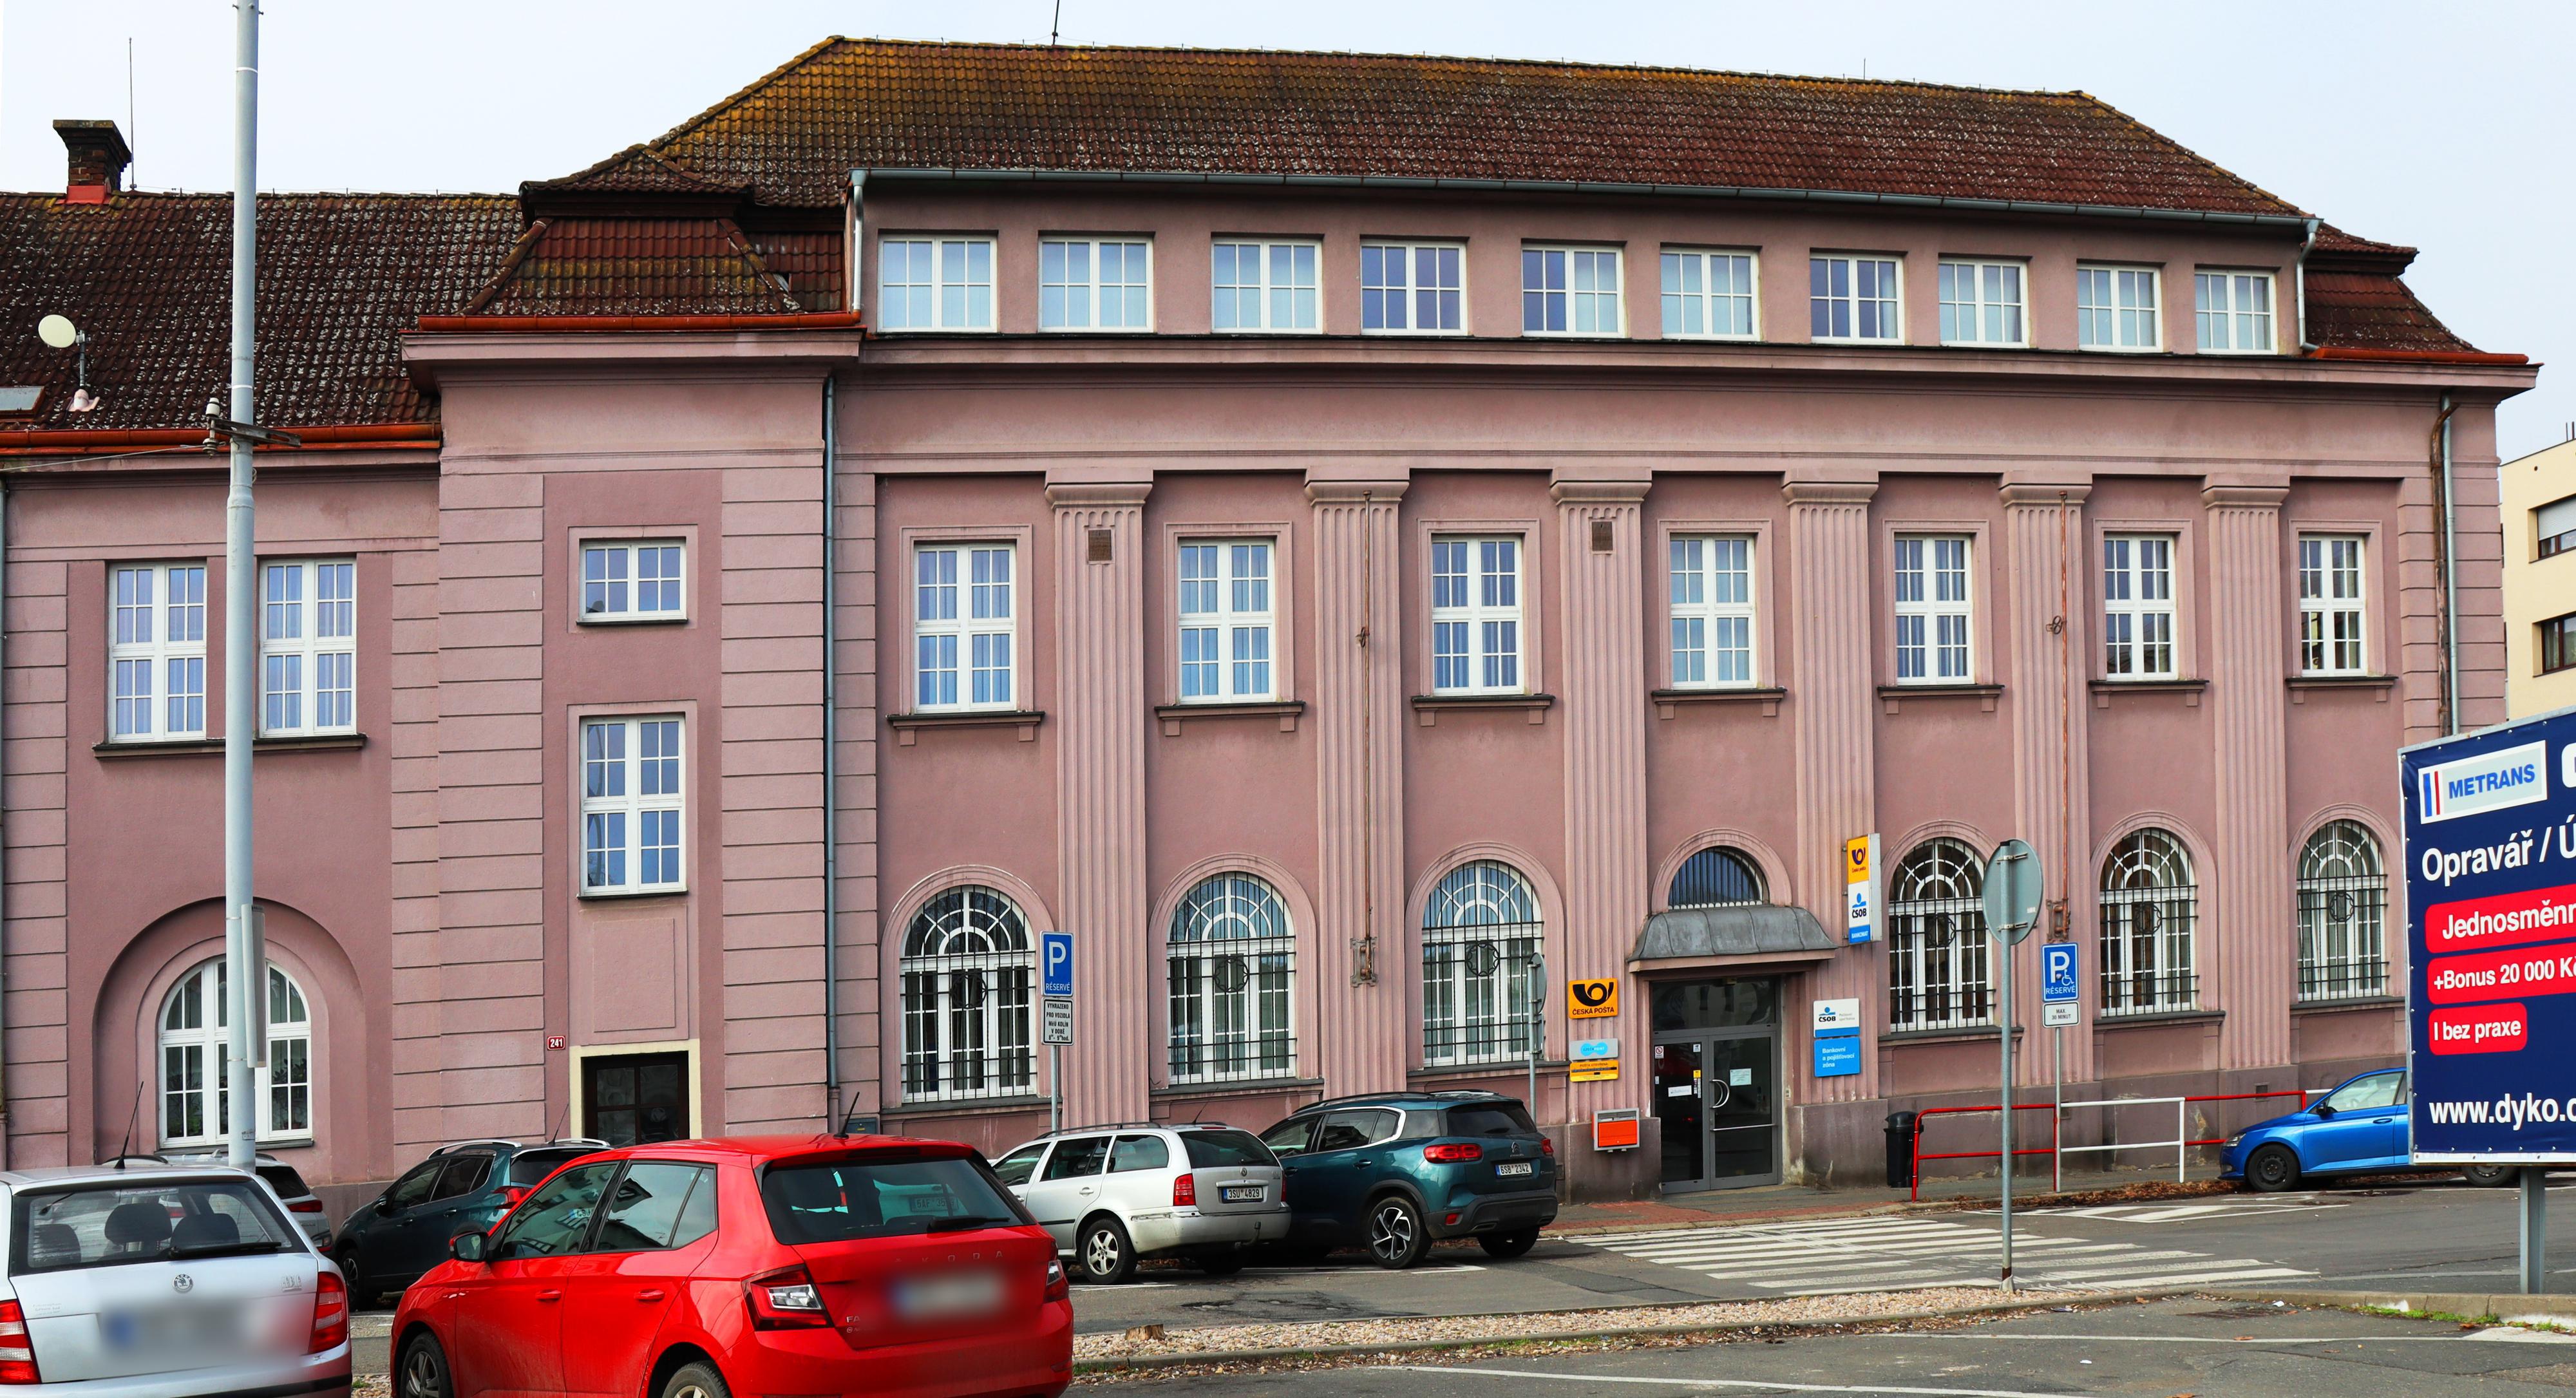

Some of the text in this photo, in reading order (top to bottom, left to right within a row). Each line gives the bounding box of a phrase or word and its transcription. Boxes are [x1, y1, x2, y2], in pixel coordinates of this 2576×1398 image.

[2448, 764, 2535, 799] METRANS
[2421, 829, 2533, 887] Opravář
[1852, 908, 1866, 918] ČSOB
[1048, 941, 1066, 977] P
[2050, 951, 2070, 983] P
[2434, 969, 2496, 990] +Bonus
[2500, 963, 2520, 985] 20
[2524, 959, 2555, 981] 000
[1045, 981, 1070, 991] RÉSERVÉ
[2046, 985, 2076, 994] RÉSERVÉ
[2434, 1020, 2521, 1044] I bez praxe
[550, 1038, 563, 1048] 241
[1500, 1164, 1511, 1174] 6SB
[1515, 1164, 1530, 1173] 2342
[1228, 1189, 1260, 1198] 3SU 4829
